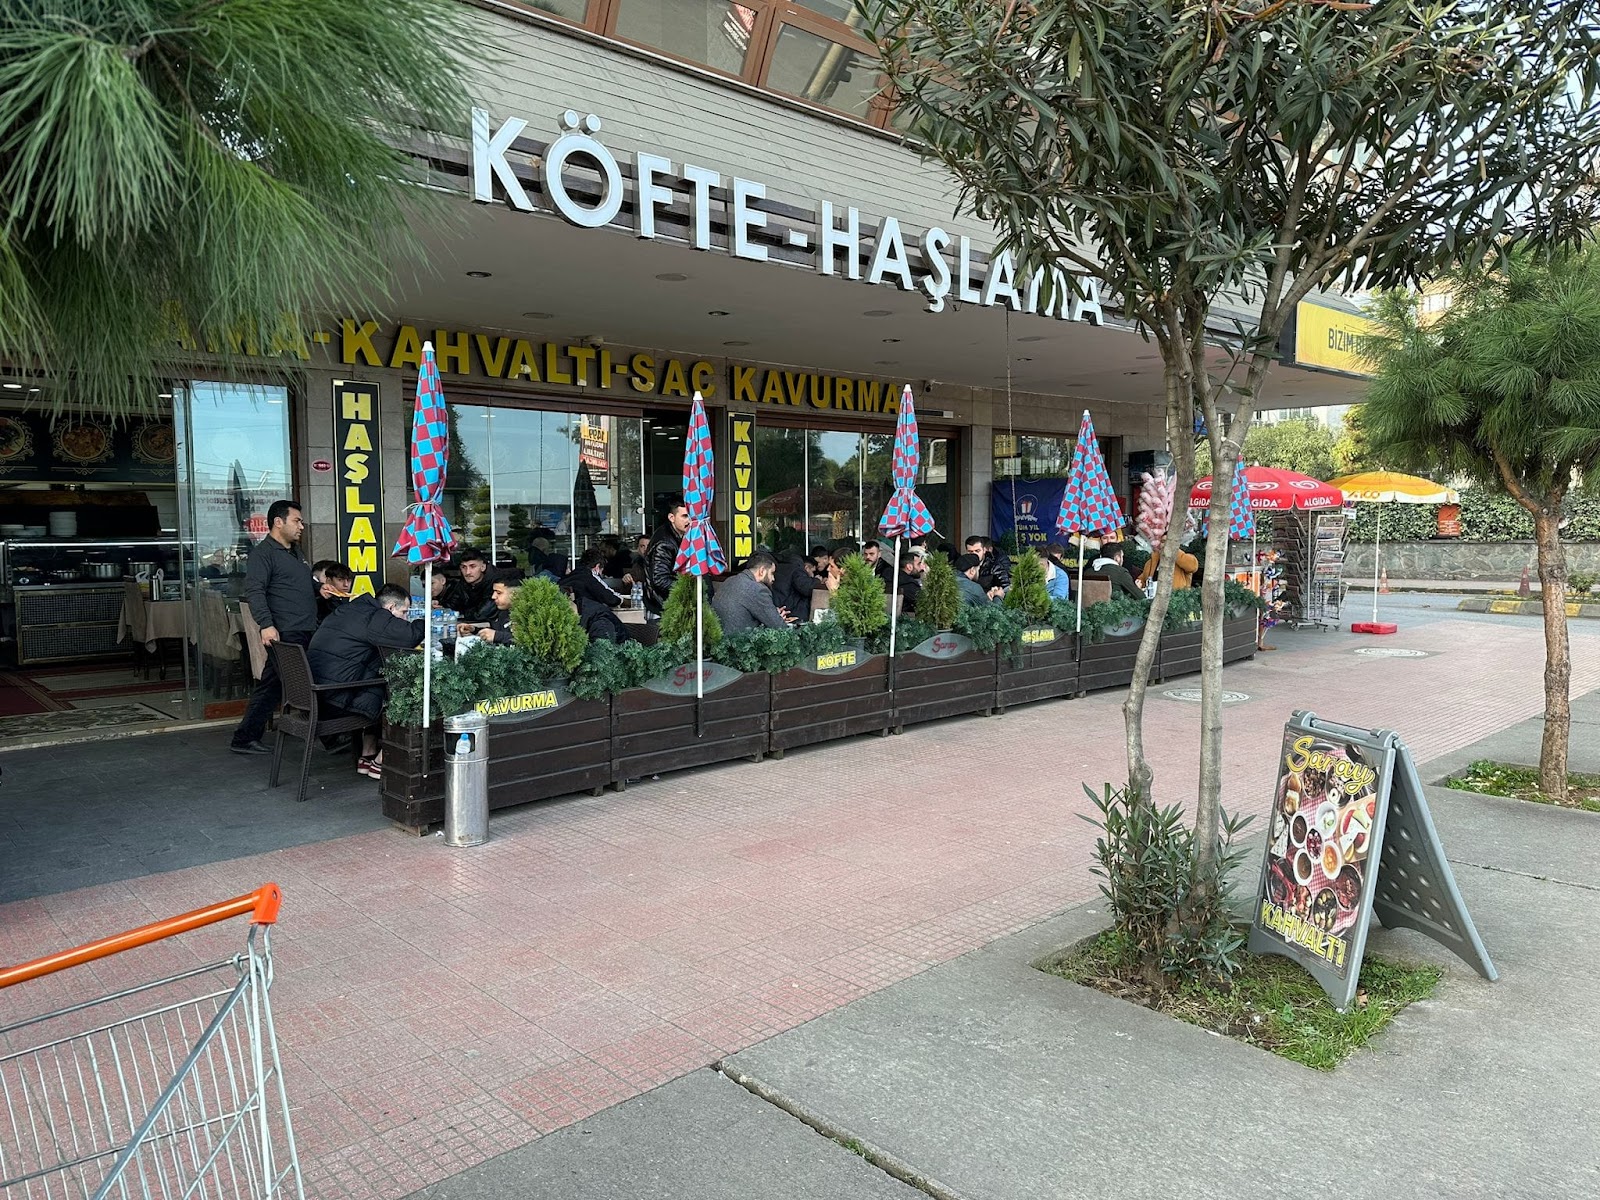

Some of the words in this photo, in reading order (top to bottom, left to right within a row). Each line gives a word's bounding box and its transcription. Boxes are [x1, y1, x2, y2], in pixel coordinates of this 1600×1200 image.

[733, 366, 900, 414] KAVURMA
[341, 391, 378, 603] HAŞLAMA
[733, 420, 752, 566] KAVURM
[816, 650, 856, 671] KÖFTE
[931, 637, 958, 653] Saray
[475, 690, 558, 716] KAVURMA
[1286, 735, 1376, 795] Saray
[1261, 898, 1347, 968] KAHVALTI
